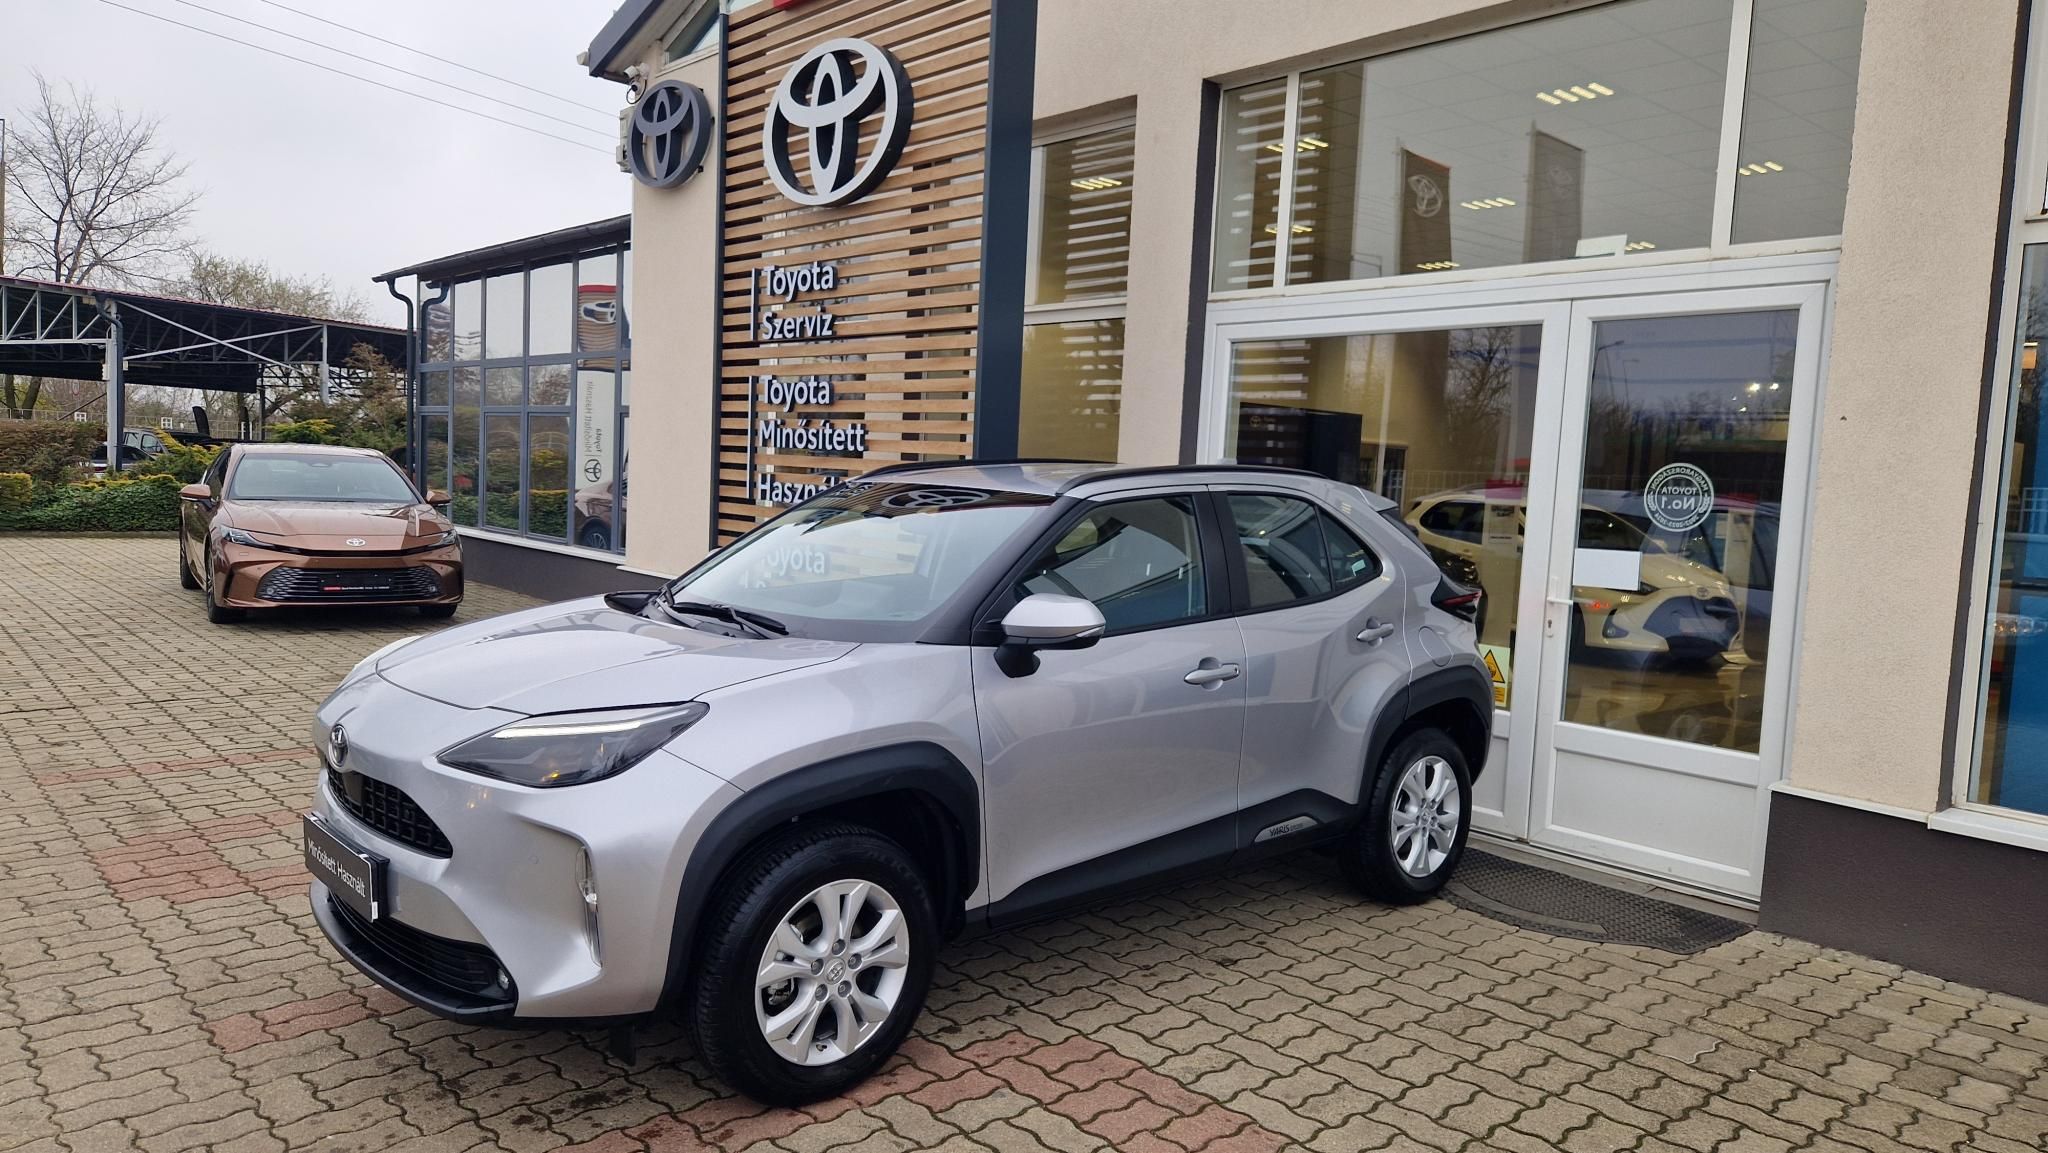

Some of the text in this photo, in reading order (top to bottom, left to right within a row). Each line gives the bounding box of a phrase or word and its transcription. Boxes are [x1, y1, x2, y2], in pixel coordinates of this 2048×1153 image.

[762, 262, 835, 301] Toyota
[762, 305, 833, 341] Szerviz
[760, 375, 831, 412] Toyota
[758, 419, 865, 452] Minősített
